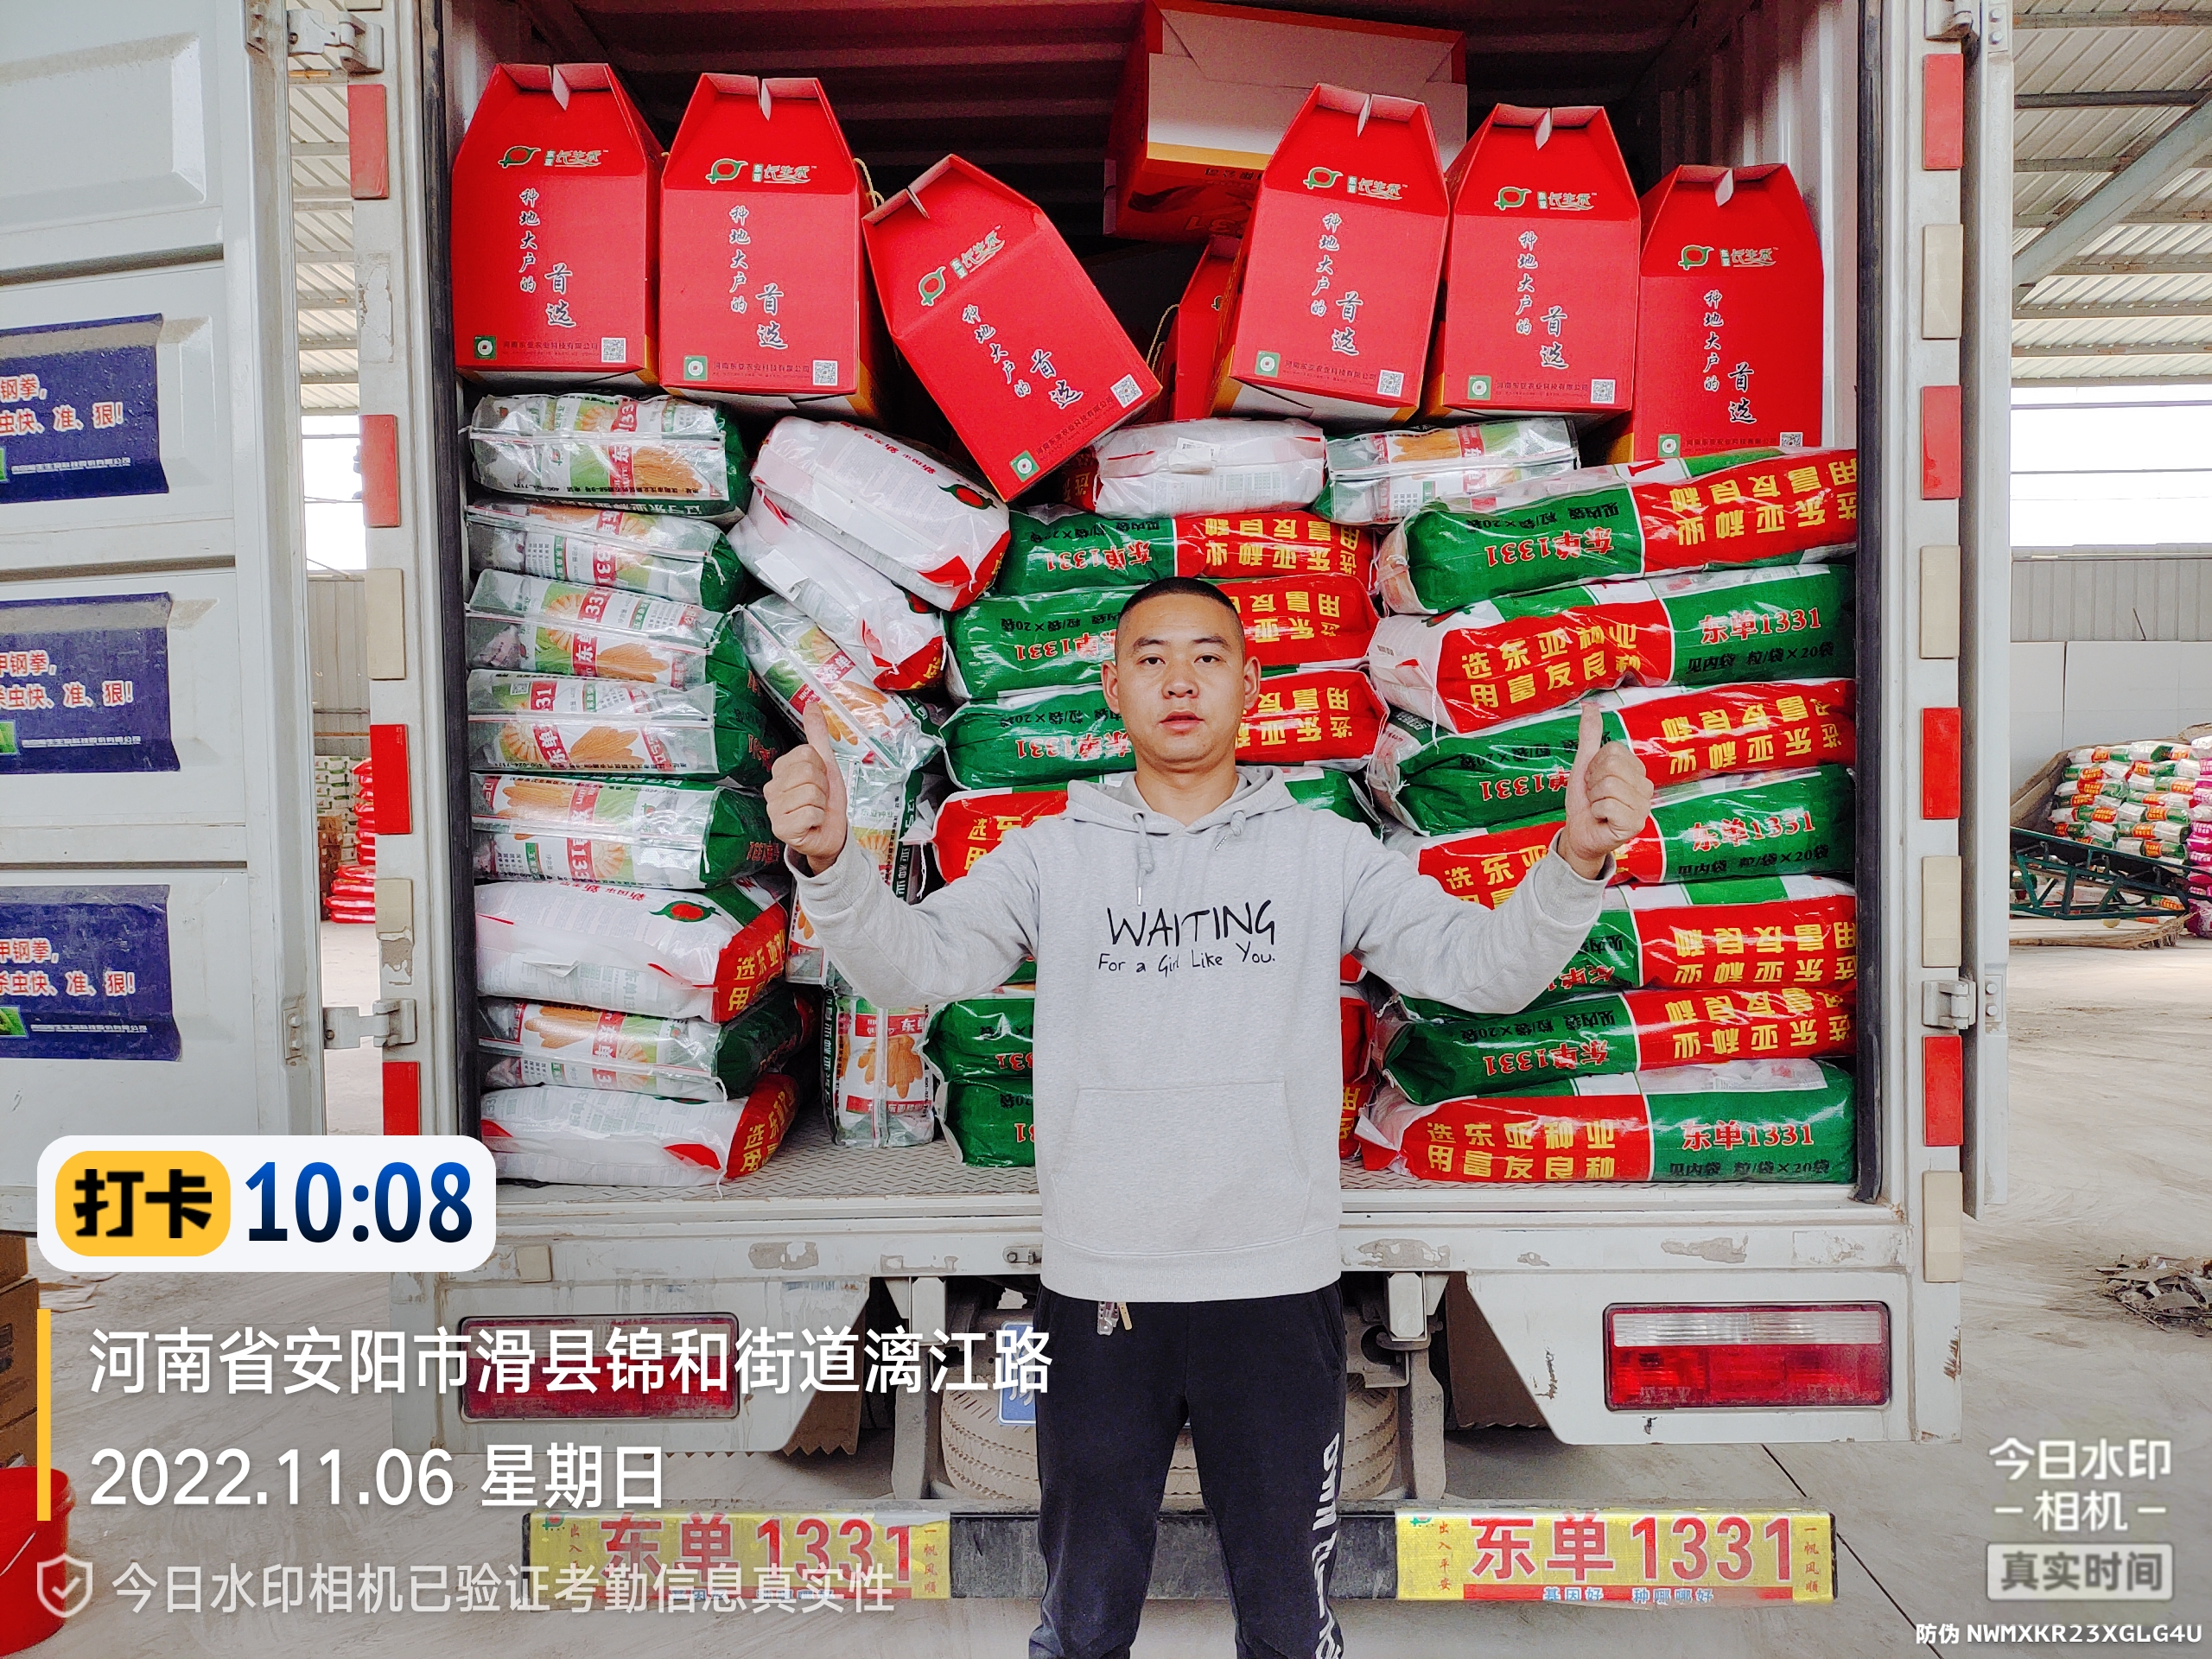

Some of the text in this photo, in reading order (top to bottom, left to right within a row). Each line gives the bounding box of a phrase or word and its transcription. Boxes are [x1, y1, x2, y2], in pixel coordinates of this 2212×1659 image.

[519, 188, 540, 294] 种地大户的
[729, 205, 750, 314] 种地大户的
[1310, 212, 1342, 318] 种地大户的
[1516, 230, 1538, 336] 种地大户的
[544, 263, 576, 328] 首选
[756, 283, 788, 350] 首选
[1331, 290, 1363, 356] 首选
[1540, 305, 1569, 370] 首选
[1704, 289, 1724, 392] 种地大户的
[962, 303, 1032, 398] 种地大户的
[1030, 348, 1084, 410] 首选
[1728, 361, 1758, 424] 首选
[1045, 539, 1152, 573] 东单1331
[1205, 518, 1360, 551] 用富友良种
[1486, 526, 1616, 567] 东单1331
[1205, 540, 1357, 576] 选东亚种业
[1001, 616, 1081, 633] 粒/袋×20袋
[1014, 629, 1116, 661] 东单1331
[1699, 606, 1822, 645] 东单1331
[1460, 623, 1639, 682] 选东亚种业
[1687, 641, 1834, 674] 见内袋 粒/袋×20袋
[1469, 651, 1643, 710] 用富友良种
[1015, 731, 1131, 763] 东单1331
[1669, 723, 1842, 775] 选东亚种业
[1689, 810, 1815, 855] 东单1331
[1107, 899, 1274, 947] WAITING
[1675, 920, 1856, 958] 用富友良种
[1098, 941, 1275, 977] For a Girl Like You.
[1673, 955, 1856, 984] 选东亚种业
[1461, 1009, 1615, 1041] 见内袋 粒/袋×20袋
[1672, 1014, 1851, 1060] 选东亚种业
[1483, 1039, 1610, 1076] 东单1331
[1427, 1121, 1616, 1150] 选东亚种业
[1681, 1119, 1814, 1152] 东单1331
[1427, 1145, 1615, 1180] 用富友良种
[1669, 1158, 1831, 1178] 见内袋 粒/袋×20袋
[600, 1511, 911, 1584] 东单1331
[1438, 1521, 1452, 1592] 出入平安
[1469, 1510, 1792, 1582] 东单1331
[1543, 1587, 1713, 1606] 基因好 种哪哪好
